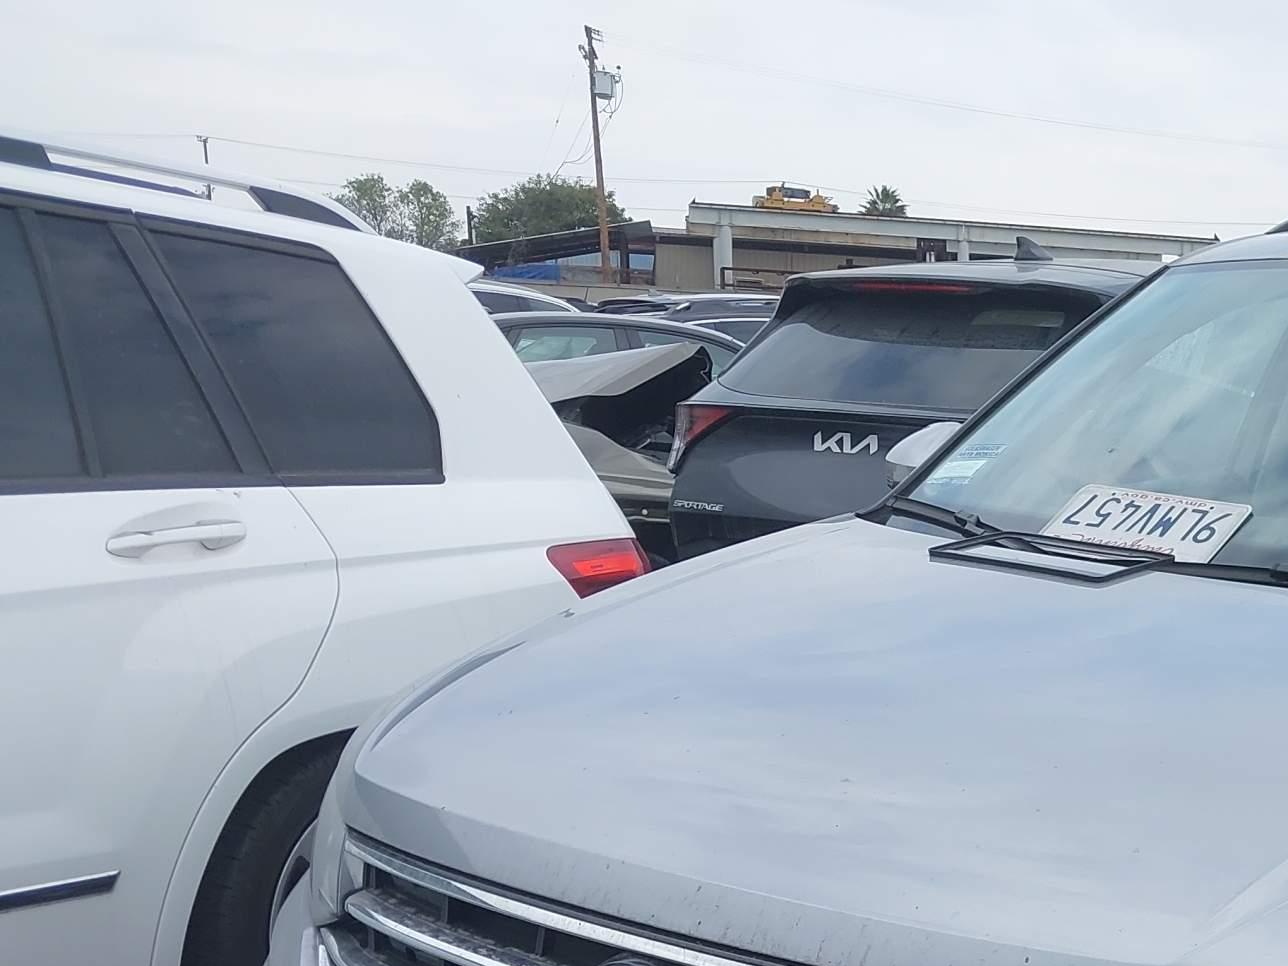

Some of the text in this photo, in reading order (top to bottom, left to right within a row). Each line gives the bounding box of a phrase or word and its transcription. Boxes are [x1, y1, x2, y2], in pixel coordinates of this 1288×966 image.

[813, 430, 879, 456] KIA
[672, 499, 724, 512] SPORTAGE
[1121, 491, 1206, 508] dmv.ca.gov
[1062, 493, 1233, 545] 9LMV457
